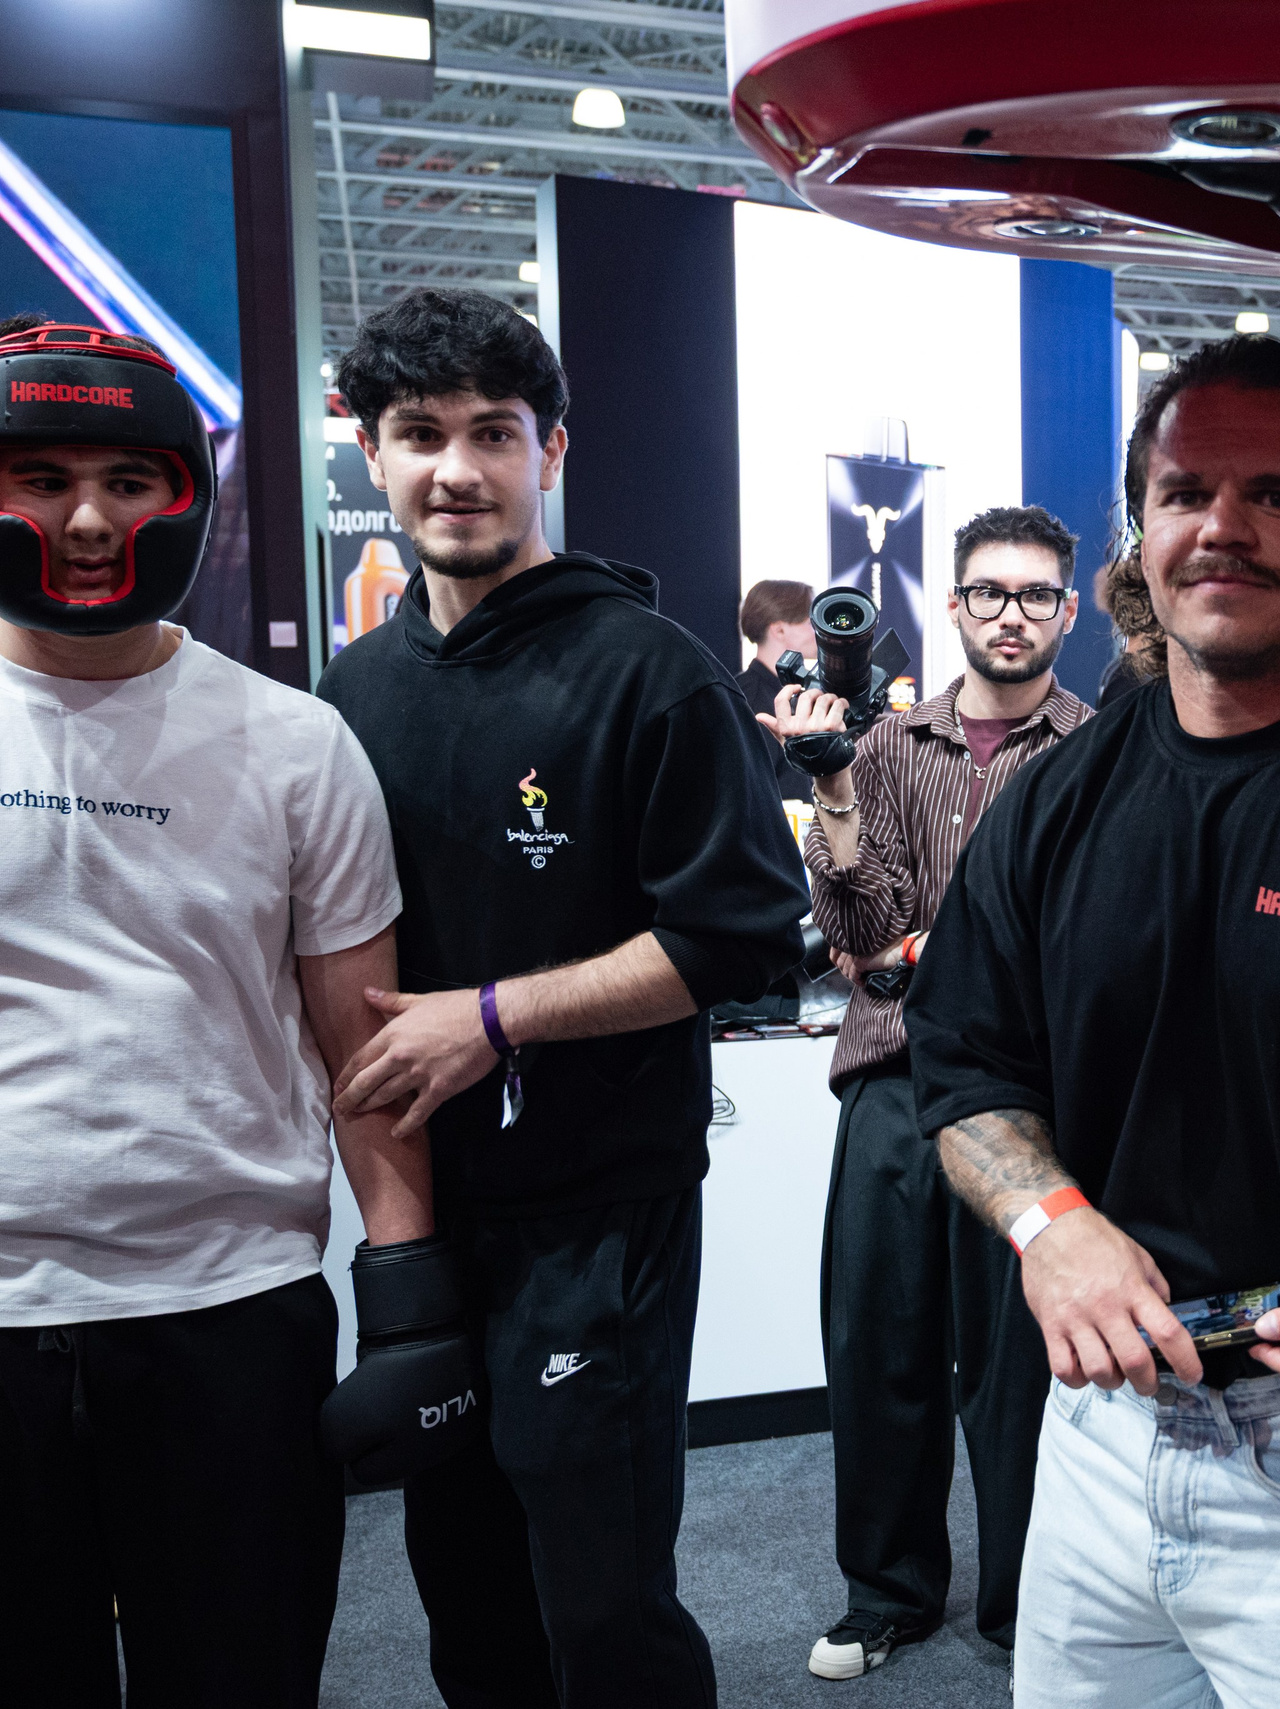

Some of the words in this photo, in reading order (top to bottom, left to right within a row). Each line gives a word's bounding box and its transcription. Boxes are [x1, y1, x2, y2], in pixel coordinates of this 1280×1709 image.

[11, 381, 134, 409] HARDCORE
[76, 796, 96, 813] to
[102, 801, 171, 826] worry
[523, 846, 554, 854] PARIS
[548, 1353, 580, 1373] NIKE
[418, 1389, 477, 1429] VLIQ
